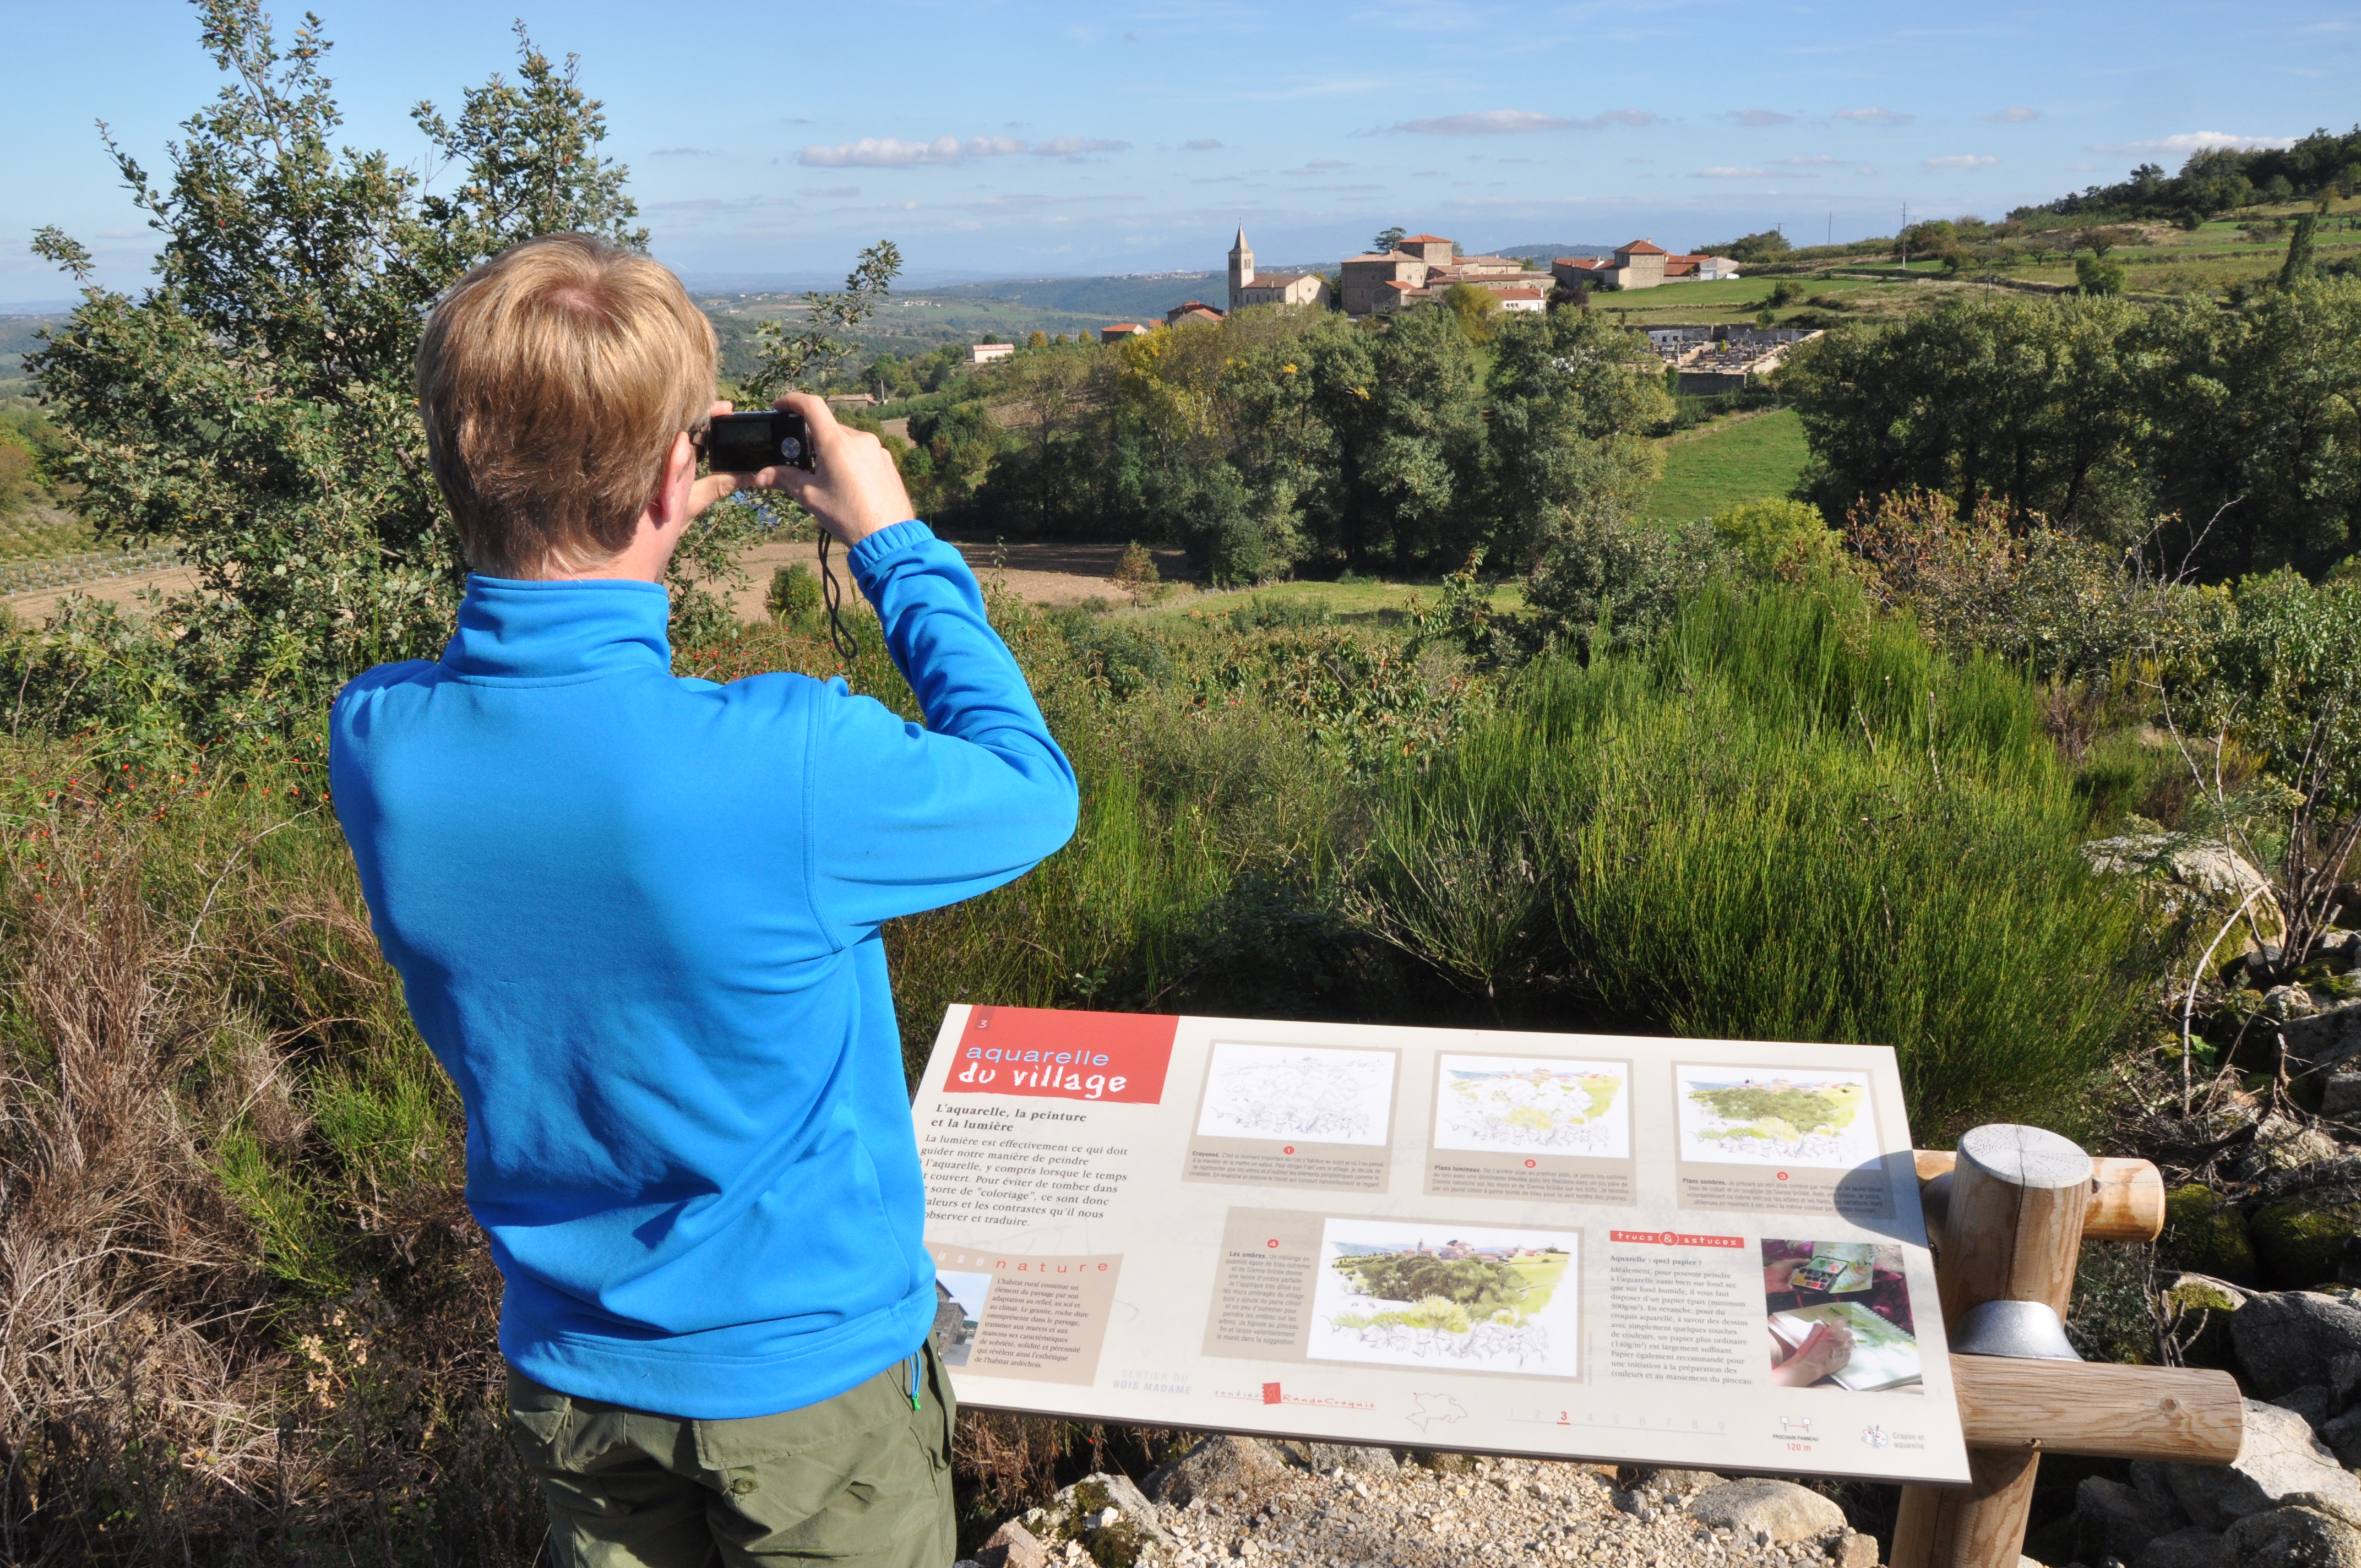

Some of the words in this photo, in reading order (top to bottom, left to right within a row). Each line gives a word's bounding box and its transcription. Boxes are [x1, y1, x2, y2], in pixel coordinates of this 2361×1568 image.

[978, 1020, 988, 1028] 3
[966, 1047, 1109, 1066] aquarelle
[959, 1061, 996, 1084] du
[1014, 1064, 1128, 1099] village
[936, 1104, 1009, 1118] L'aquarelle,
[1015, 1108, 1026, 1118] la
[1030, 1110, 1087, 1122] peinture
[948, 1119, 959, 1128] la
[963, 1120, 1014, 1131] lumière
[925, 1134, 937, 1142] La
[939, 1135, 978, 1146] lumière
[999, 1139, 1068, 1152] effectivement
[1086, 1146, 1103, 1156] qui
[1106, 1146, 1128, 1156] doit
[920, 1147, 955, 1156] guider
[987, 1152, 1029, 1161] manière
[1032, 1154, 1046, 1162] de
[1047, 1156, 1089, 1166] peindre
[926, 1158, 982, 1172] l'aquarelle,
[985, 1165, 992, 1173] y
[994, 1166, 1036, 1175] compris
[1040, 1167, 1079, 1179] lorsque
[1082, 1169, 1092, 1178] le
[1095, 1172, 1127, 1183] temps
[930, 1174, 971, 1183] couvert.
[975, 1175, 1000, 1185] Pour
[1002, 1177, 1033, 1187] éviter
[1035, 1179, 1048, 1188] de
[1052, 1182, 1090, 1191] tomber
[1093, 1183, 1118, 1193] dans
[960, 1186, 973, 1196] de
[977, 1187, 1036, 1201] "coloriage",
[1082, 1195, 1109, 1206] donc
[925, 1197, 958, 1207] aleurs
[975, 1201, 989, 1210] les
[992, 1204, 1046, 1214] contrastes
[1049, 1207, 1075, 1217] qu'il
[1078, 1210, 1103, 1218] nous
[984, 1216, 1030, 1226] traduire.
[1618, 1232, 1653, 1241] trucs
[1663, 1234, 1673, 1243] &
[1684, 1236, 1736, 1246] astuces
[995, 1259, 1108, 1273] nature
[997, 1278, 1023, 1286] L'habitat
[992, 1295, 1025, 1304] adaptation
[987, 1313, 1030, 1322] omniprésente
[988, 1339, 1015, 1348] sobriété,
[1017, 1342, 1041, 1350] solidité
[1049, 1344, 1081, 1353] pérennité
[1019, 1334, 1068, 1344] caractéristiques
[988, 1348, 1015, 1357] révèlent
[1031, 1352, 1069, 1362] l'esthétique
[983, 1357, 1009, 1365] l'habitat
[1010, 1360, 1042, 1368] ardéchois.
[1121, 1369, 1168, 1381] SENTIER
[1113, 1380, 1139, 1390] BOIS
[1144, 1382, 1192, 1395] MADAME
[1561, 1411, 1567, 1420] 3
[1892, 1432, 1916, 1441] Crayon
